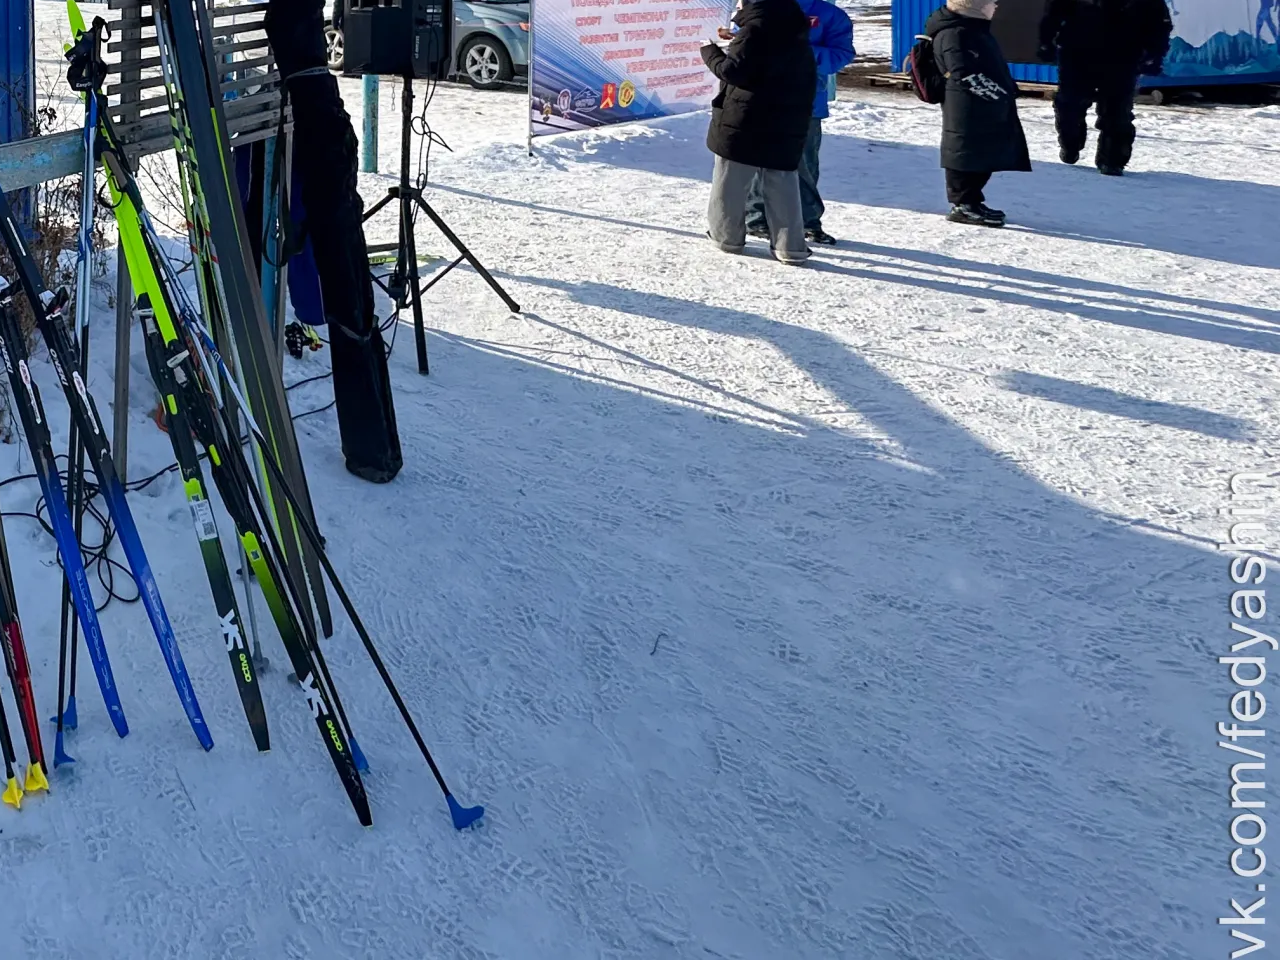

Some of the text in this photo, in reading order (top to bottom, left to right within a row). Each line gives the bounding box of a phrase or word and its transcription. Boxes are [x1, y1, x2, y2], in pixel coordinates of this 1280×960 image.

[75, 570, 93, 623] SKATE
[145, 578, 168, 634] SKATE
[90, 626, 104, 662] PRO
[166, 637, 182, 674] PRO
[238, 652, 252, 683] active
[325, 719, 343, 752] active
